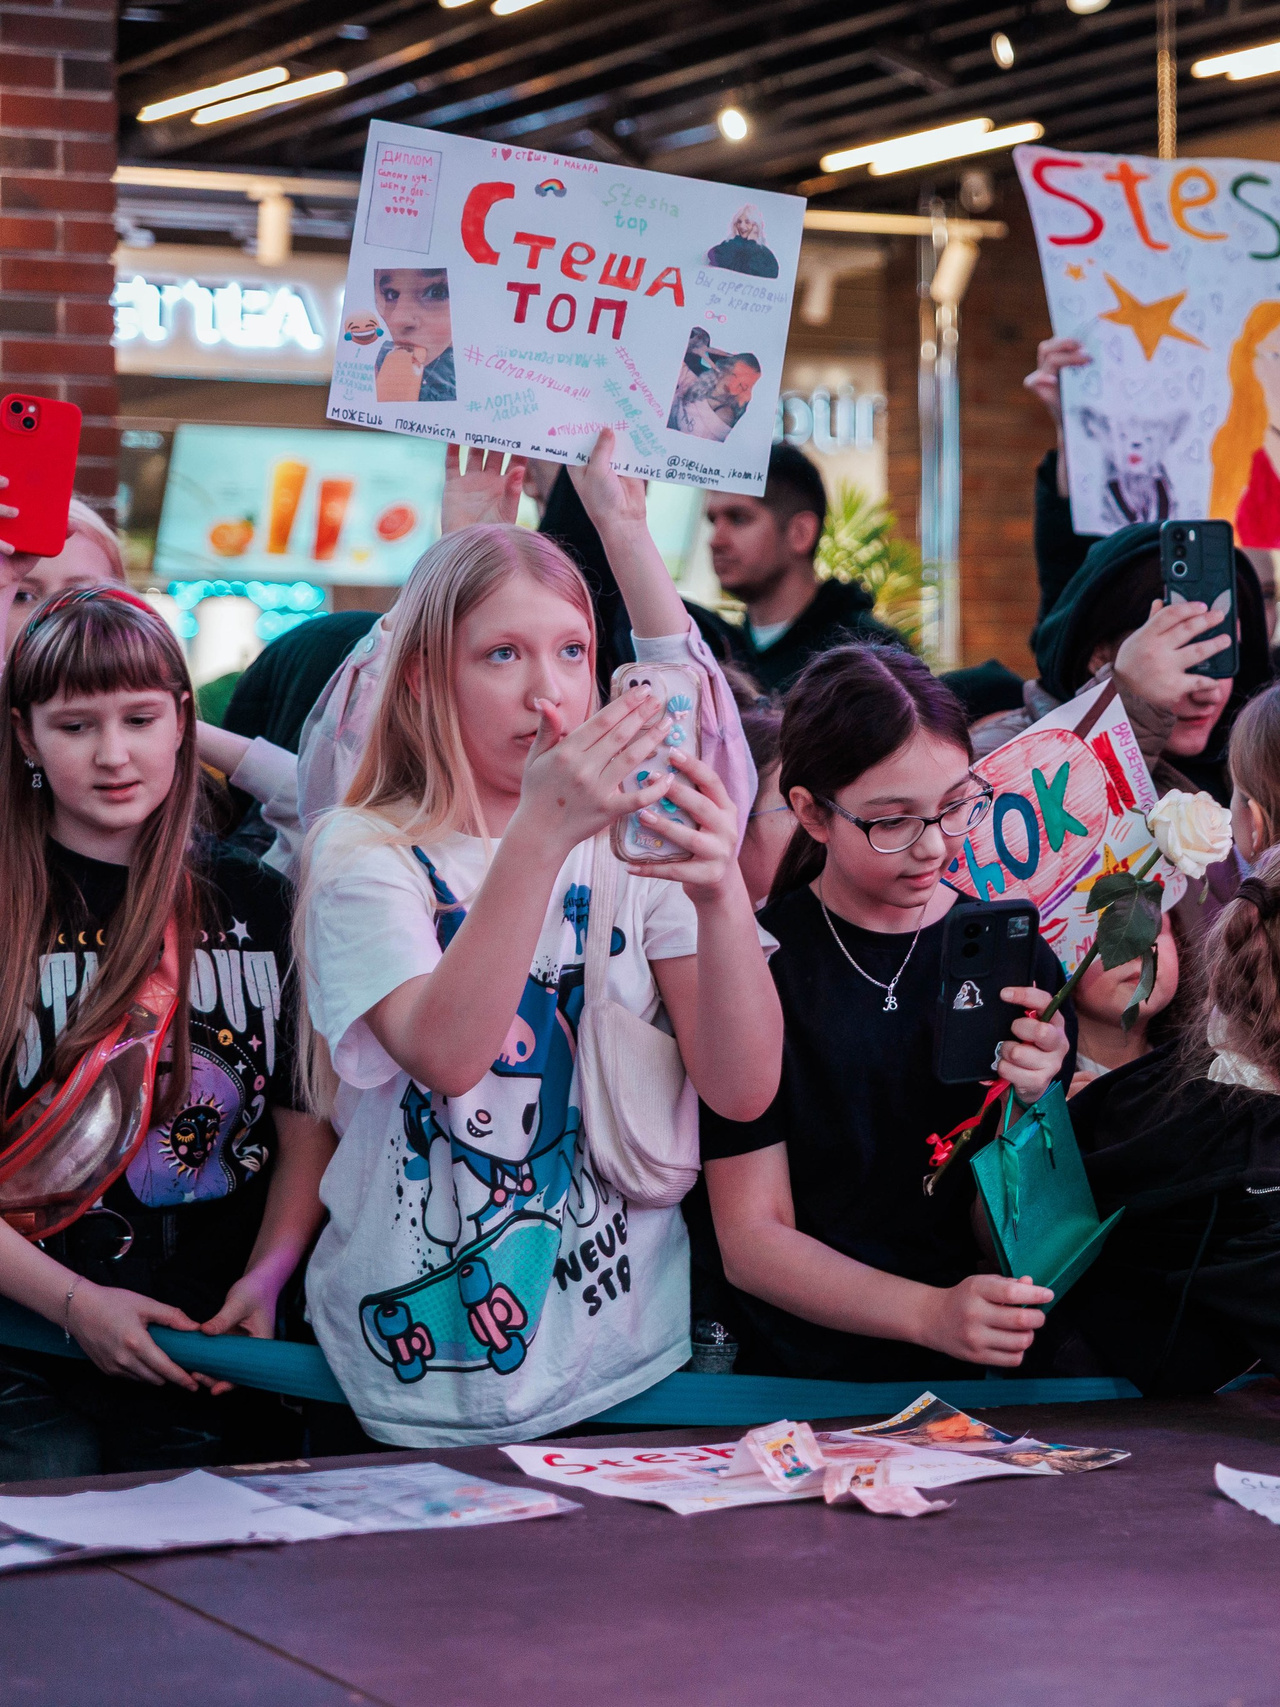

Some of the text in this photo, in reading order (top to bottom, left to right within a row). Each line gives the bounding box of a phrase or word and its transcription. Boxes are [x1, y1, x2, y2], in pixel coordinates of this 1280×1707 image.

[381, 150, 433, 167] ДИПЛОМ
[506, 282, 630, 341] ТОП
[331, 407, 383, 426] МОЖЕШЬ
[395, 418, 456, 438] ПОЖАЛУЙСТА
[1111, 721, 1133, 748] ВАУ
